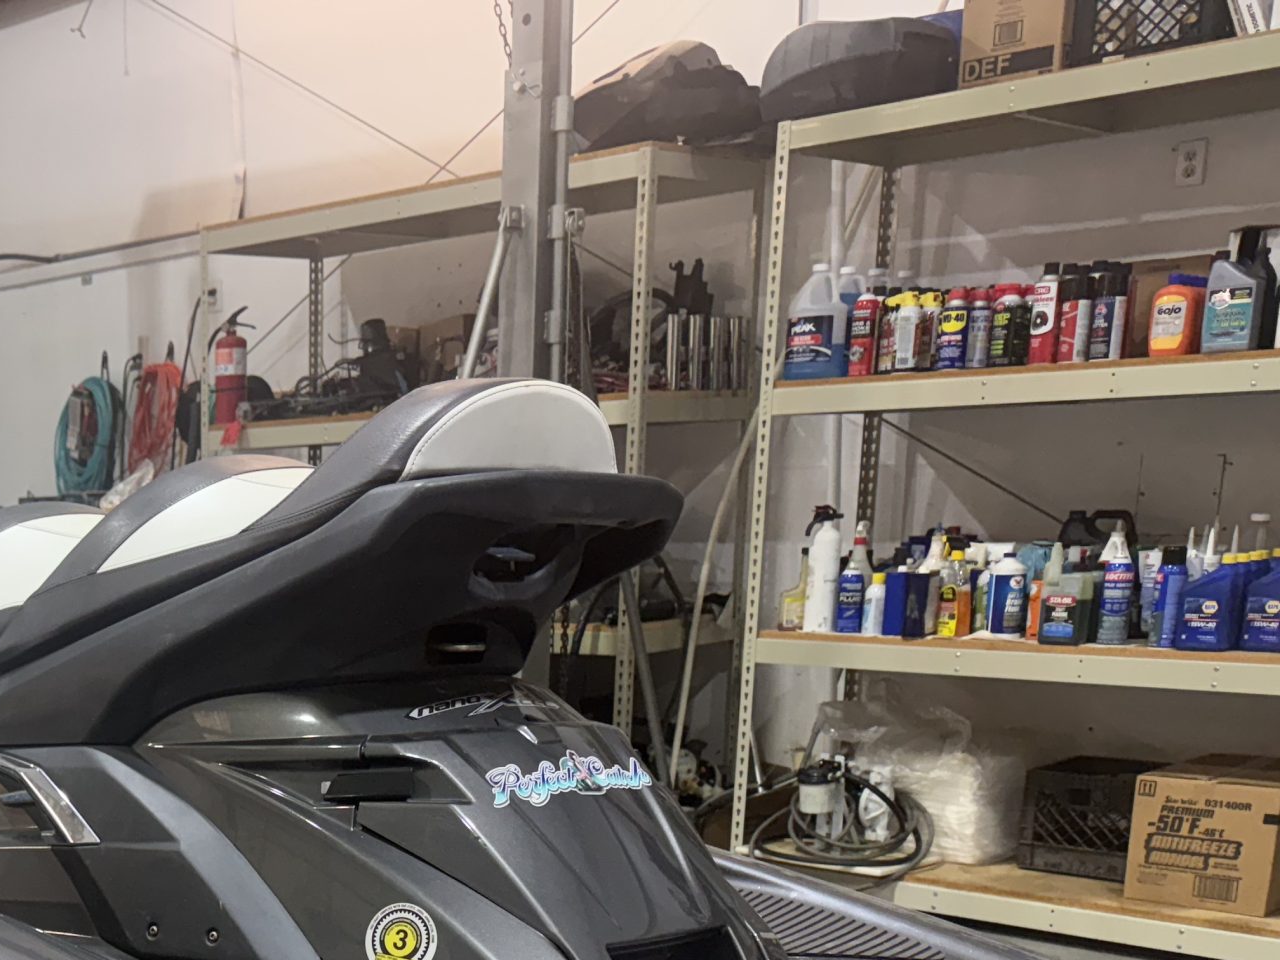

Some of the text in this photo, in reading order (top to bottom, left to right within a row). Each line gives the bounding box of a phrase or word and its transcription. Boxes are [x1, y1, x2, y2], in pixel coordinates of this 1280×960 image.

[963, 54, 1011, 81] DEF
[943, 312, 965, 323] WD-40
[1104, 572, 1136, 581] LOCTITE
[1160, 804, 1215, 819] PREMIUM
[1150, 835, 1239, 857] ANTIFREEZE
[392, 929, 409, 951] 3
